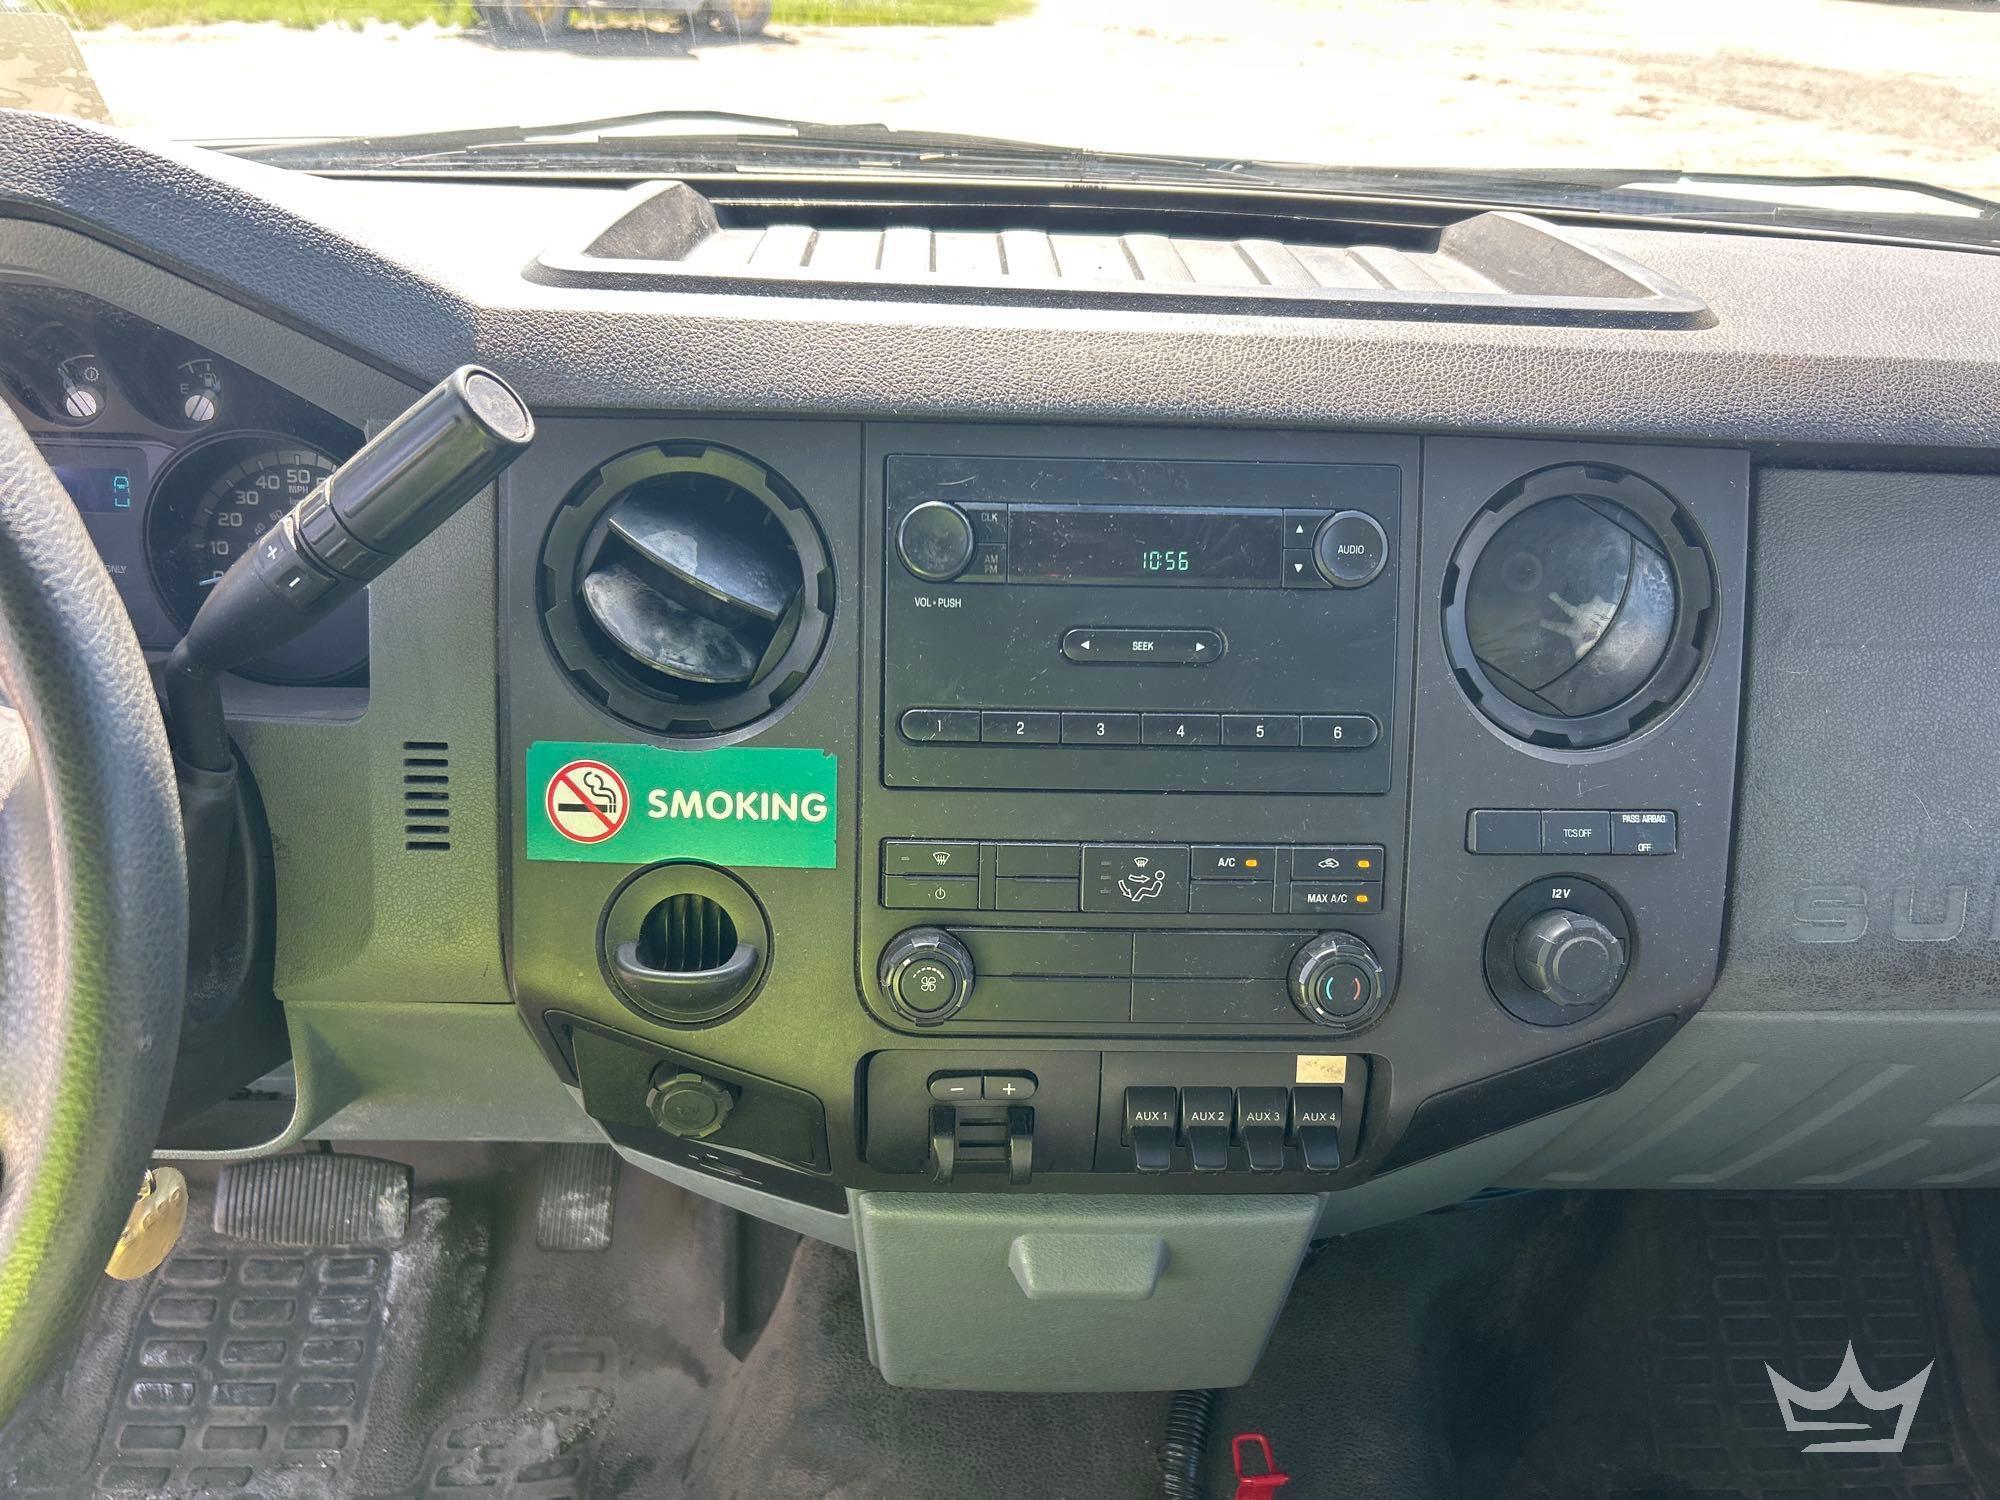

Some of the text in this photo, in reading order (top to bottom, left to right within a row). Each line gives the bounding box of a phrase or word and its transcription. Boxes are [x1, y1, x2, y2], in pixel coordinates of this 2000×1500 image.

[255, 475, 280, 489] 40
[287, 469, 310, 484] 50
[288, 485, 309, 494] MPH
[235, 491, 259, 505] 30
[218, 512, 242, 527] 20
[980, 512, 999, 523] CLK
[210, 540, 229, 555] 10
[1337, 544, 1365, 555] AUDIO
[1142, 551, 1189, 571] 10:56
[1132, 641, 1154, 651] SEEK
[1016, 721, 1025, 734] 2
[1096, 723, 1105, 736] 3
[1176, 724, 1185, 738] 4
[1256, 725, 1265, 738] 5
[1333, 726, 1343, 740] 6
[647, 788, 828, 822] SMOKING
[1622, 814, 1666, 824] PASS AIRBAG
[1563, 828, 1593, 838] TCS OFF
[1637, 843, 1652, 852] OFF
[1217, 857, 1236, 868] A/C
[1307, 893, 1348, 904] MAX A/C
[1790, 883, 2000, 943] SU
[1135, 1112, 1168, 1121] AUX 1
[1191, 1112, 1225, 1121] AUX 2
[1247, 1112, 1281, 1121] AUX 3
[1302, 1112, 1337, 1122] AUX 4
